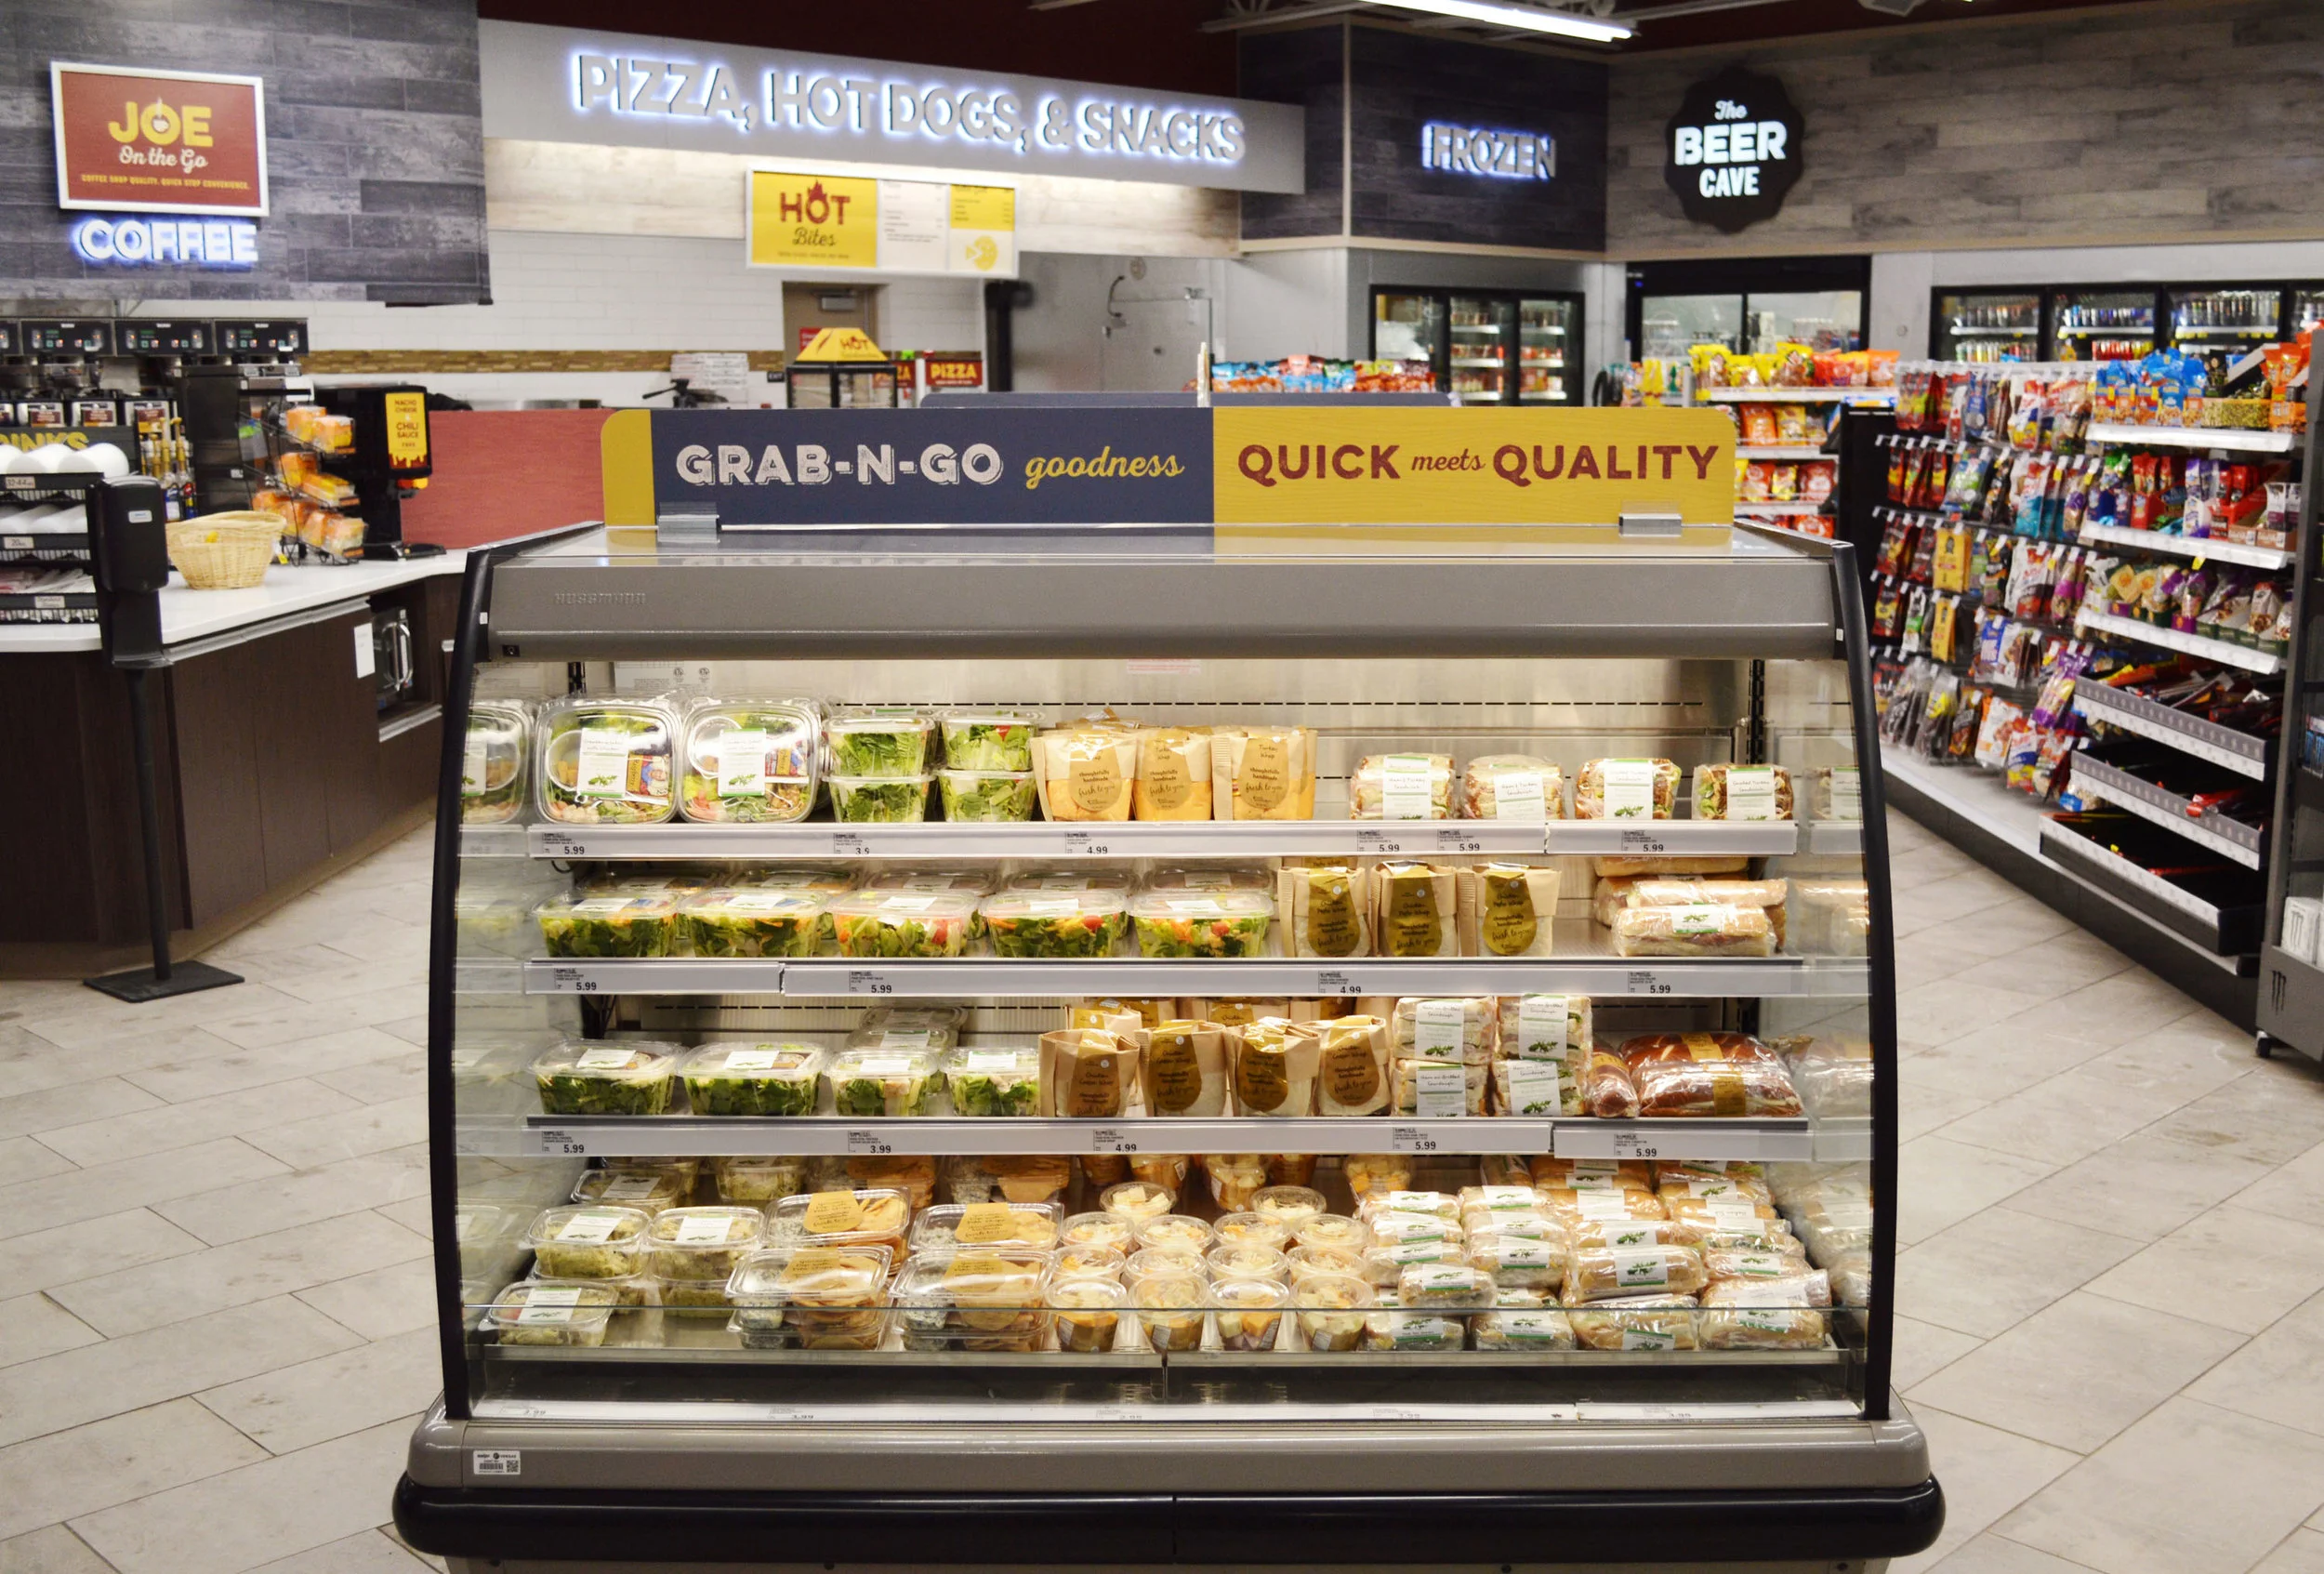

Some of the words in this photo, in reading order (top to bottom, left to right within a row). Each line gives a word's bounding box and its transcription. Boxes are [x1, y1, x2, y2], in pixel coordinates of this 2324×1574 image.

[578, 55, 759, 131] PIZZA,
[771, 73, 879, 129] HOT
[889, 84, 1032, 152] DOGS,
[1042, 99, 1072, 149] &
[1083, 103, 1246, 162] SNACKS
[1714, 99, 1748, 120] The
[108, 101, 214, 147] JOE
[1675, 121, 1788, 165] BEER
[1426, 126, 1556, 179] FROZEN
[119, 145, 147, 165] On
[148, 147, 178, 167] the
[180, 149, 209, 174] Go
[81, 173, 108, 183] COFFEE
[1699, 166, 1760, 198] CAVE
[779, 191, 851, 225] HOT
[79, 218, 258, 261] COFFEE
[793, 227, 837, 247] Bites
[931, 363, 978, 379] PIZZA
[676, 443, 1004, 485] GRAB-N-GO
[1024, 445, 1185, 489] goodness
[1237, 444, 1401, 487] QUICK
[1411, 448, 1486, 472] meets
[1493, 444, 1720, 487] QUALITY
[564, 845, 586, 855] 5.99
[1087, 846, 1108, 854] 4.99
[1379, 843, 1400, 852] 5.99
[1459, 843, 1481, 852] 5.99
[1643, 843, 1664, 853] 5.99
[576, 981, 597, 991] 5.99
[870, 985, 892, 994] 5.99
[1340, 985, 1362, 994] 4.99
[1650, 985, 1670, 993] 5.99
[563, 1144, 585, 1153] 5.99
[870, 1144, 891, 1154] 3.99
[1116, 1144, 1137, 1152] 4.99
[1415, 1141, 1436, 1150] 5.99
[1636, 1148, 1657, 1157] 5.99
